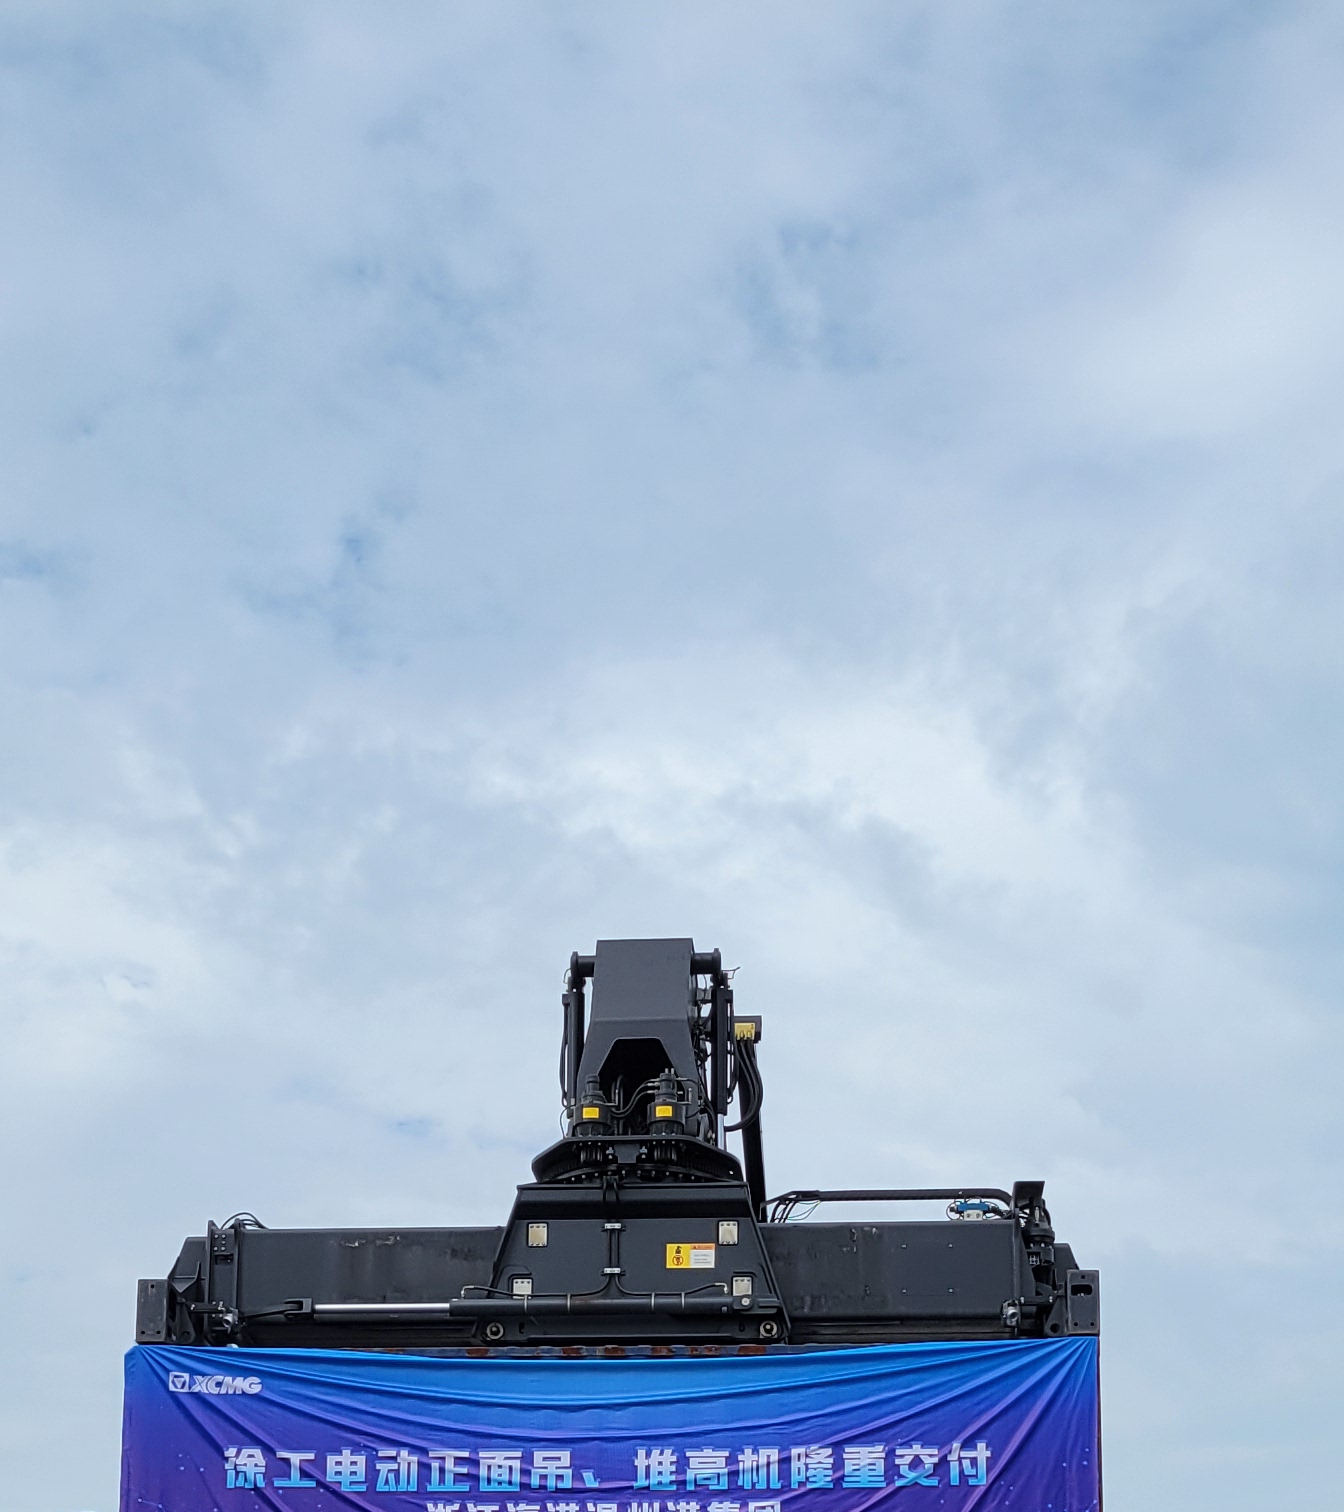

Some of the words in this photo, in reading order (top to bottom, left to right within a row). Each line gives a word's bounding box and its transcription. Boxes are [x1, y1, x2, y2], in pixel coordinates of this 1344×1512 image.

[190, 1375, 263, 1395] XCMG
[224, 1444, 992, 1493] 徐工电动正面吊、堆高机隆重交付
